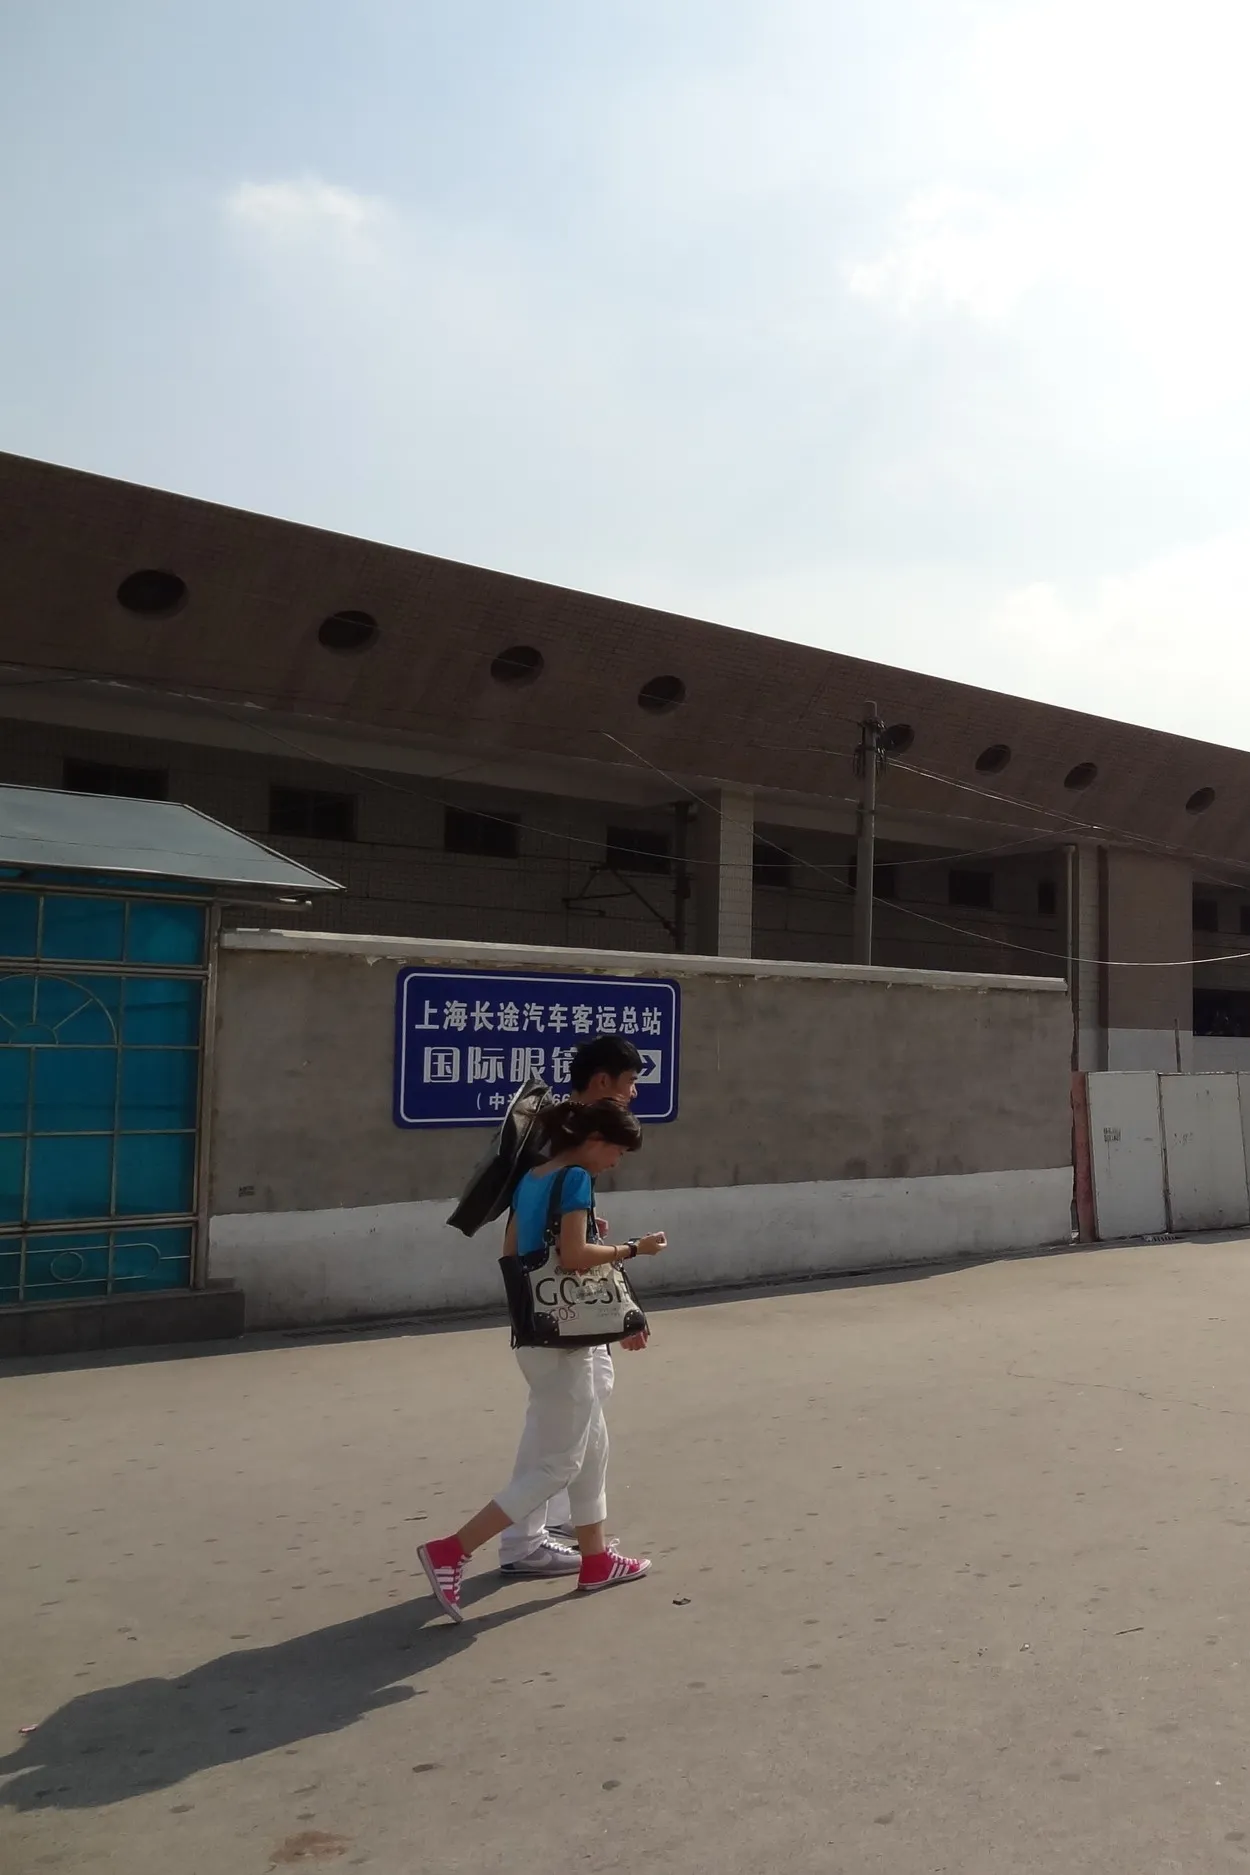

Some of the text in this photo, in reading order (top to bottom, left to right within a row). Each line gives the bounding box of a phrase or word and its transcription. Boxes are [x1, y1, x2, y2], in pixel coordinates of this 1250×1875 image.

[415, 1000, 662, 1035] 上海长途汽车客运总站
